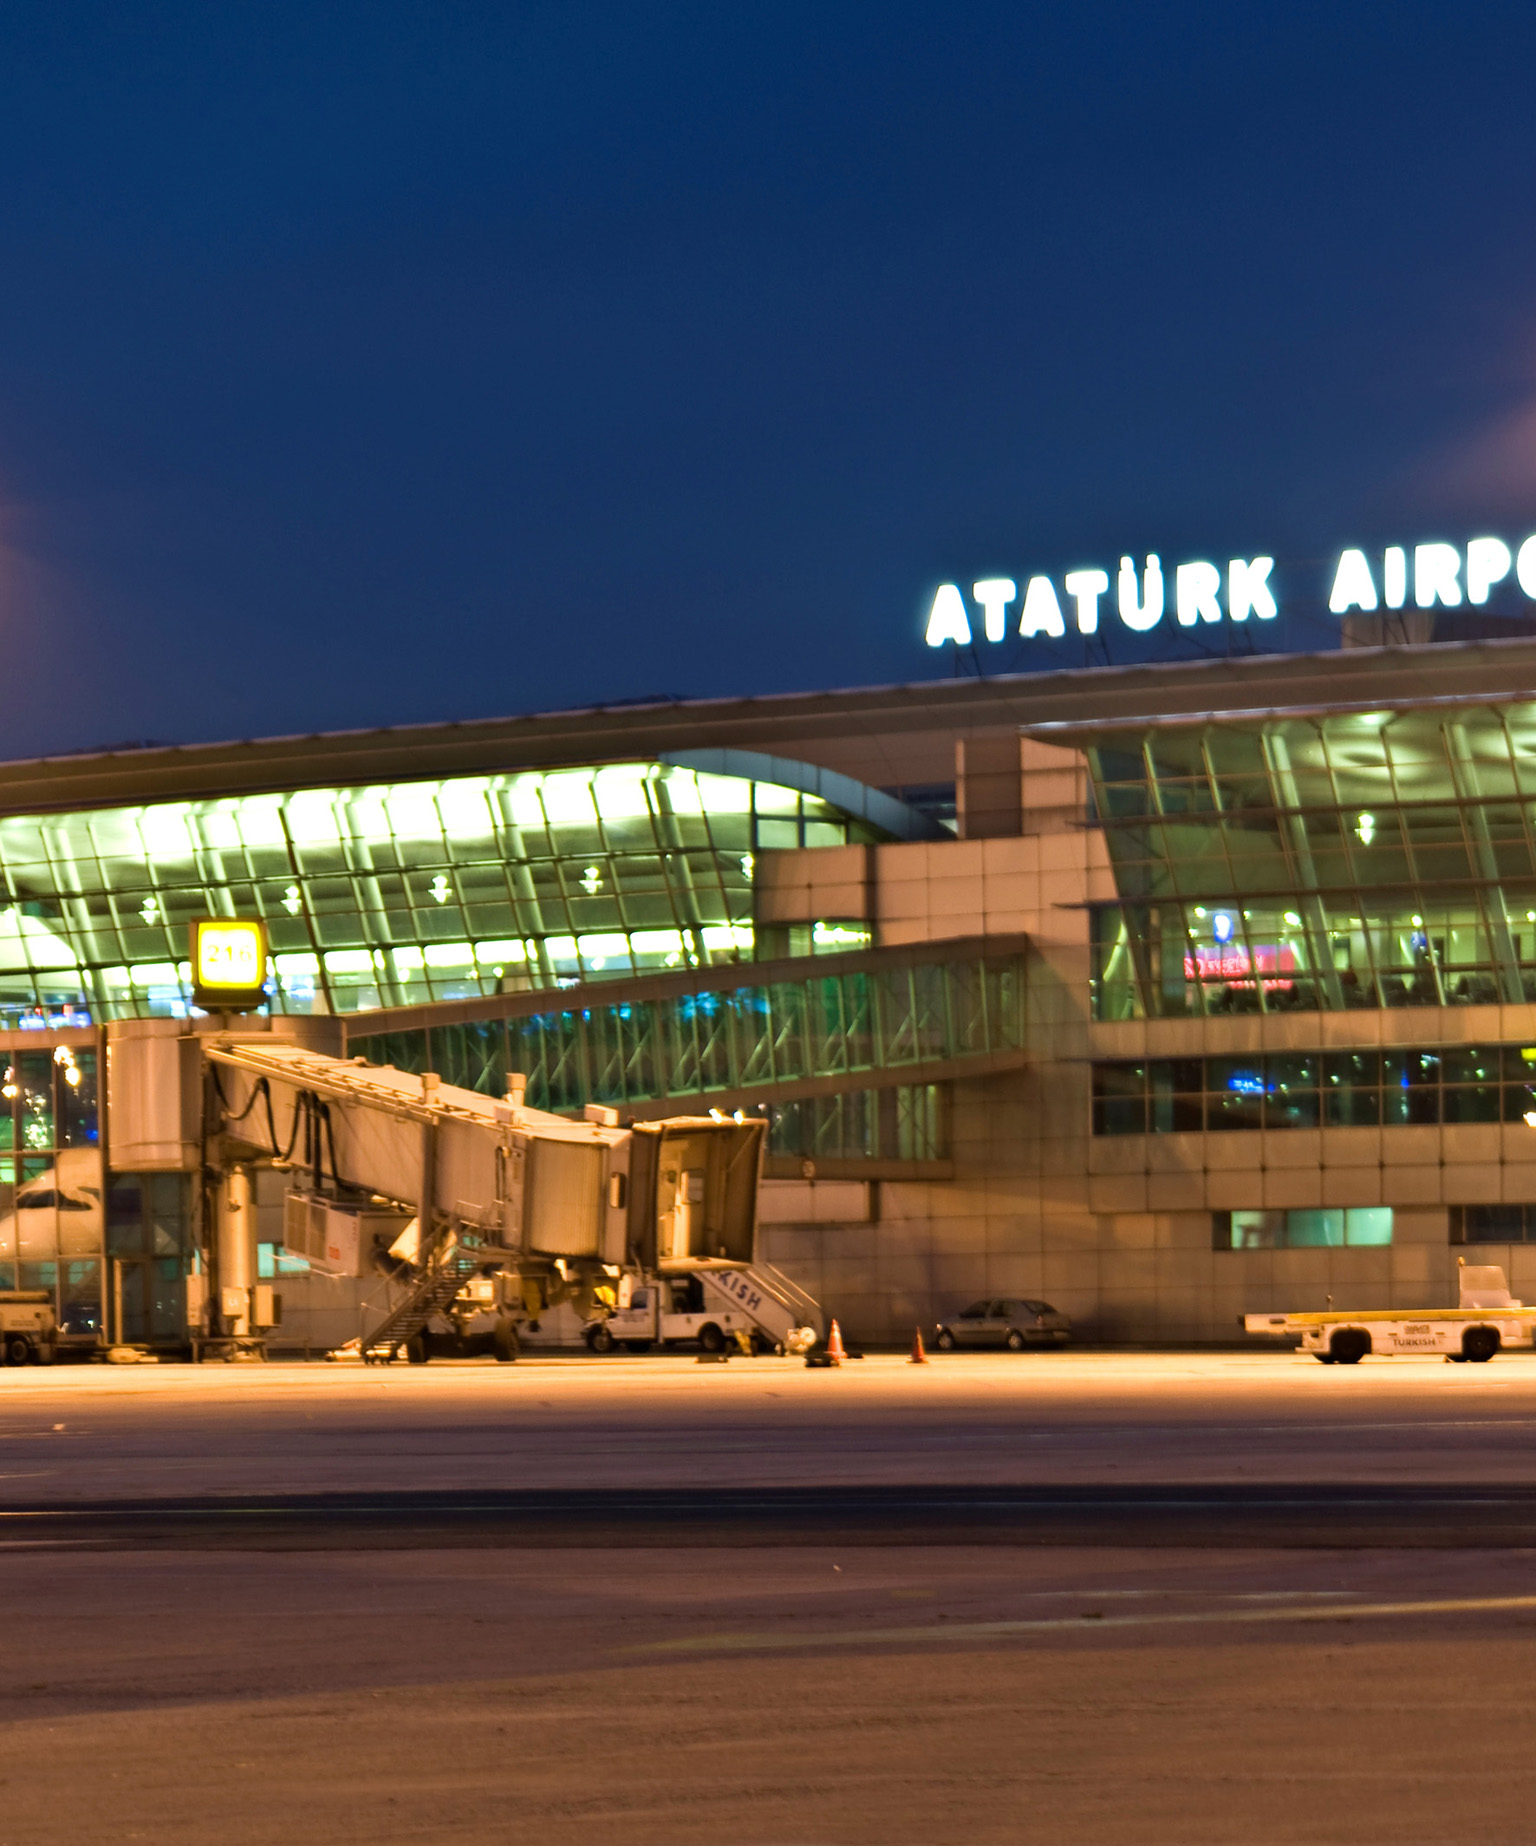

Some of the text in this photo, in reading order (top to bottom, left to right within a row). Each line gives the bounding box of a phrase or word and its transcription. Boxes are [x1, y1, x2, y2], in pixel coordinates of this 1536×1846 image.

[925, 553, 1278, 647] ATATÜRK
[207, 944, 252, 962] 216
[711, 1271, 762, 1311] KISH
[1393, 1338, 1436, 1346] TURKISH
